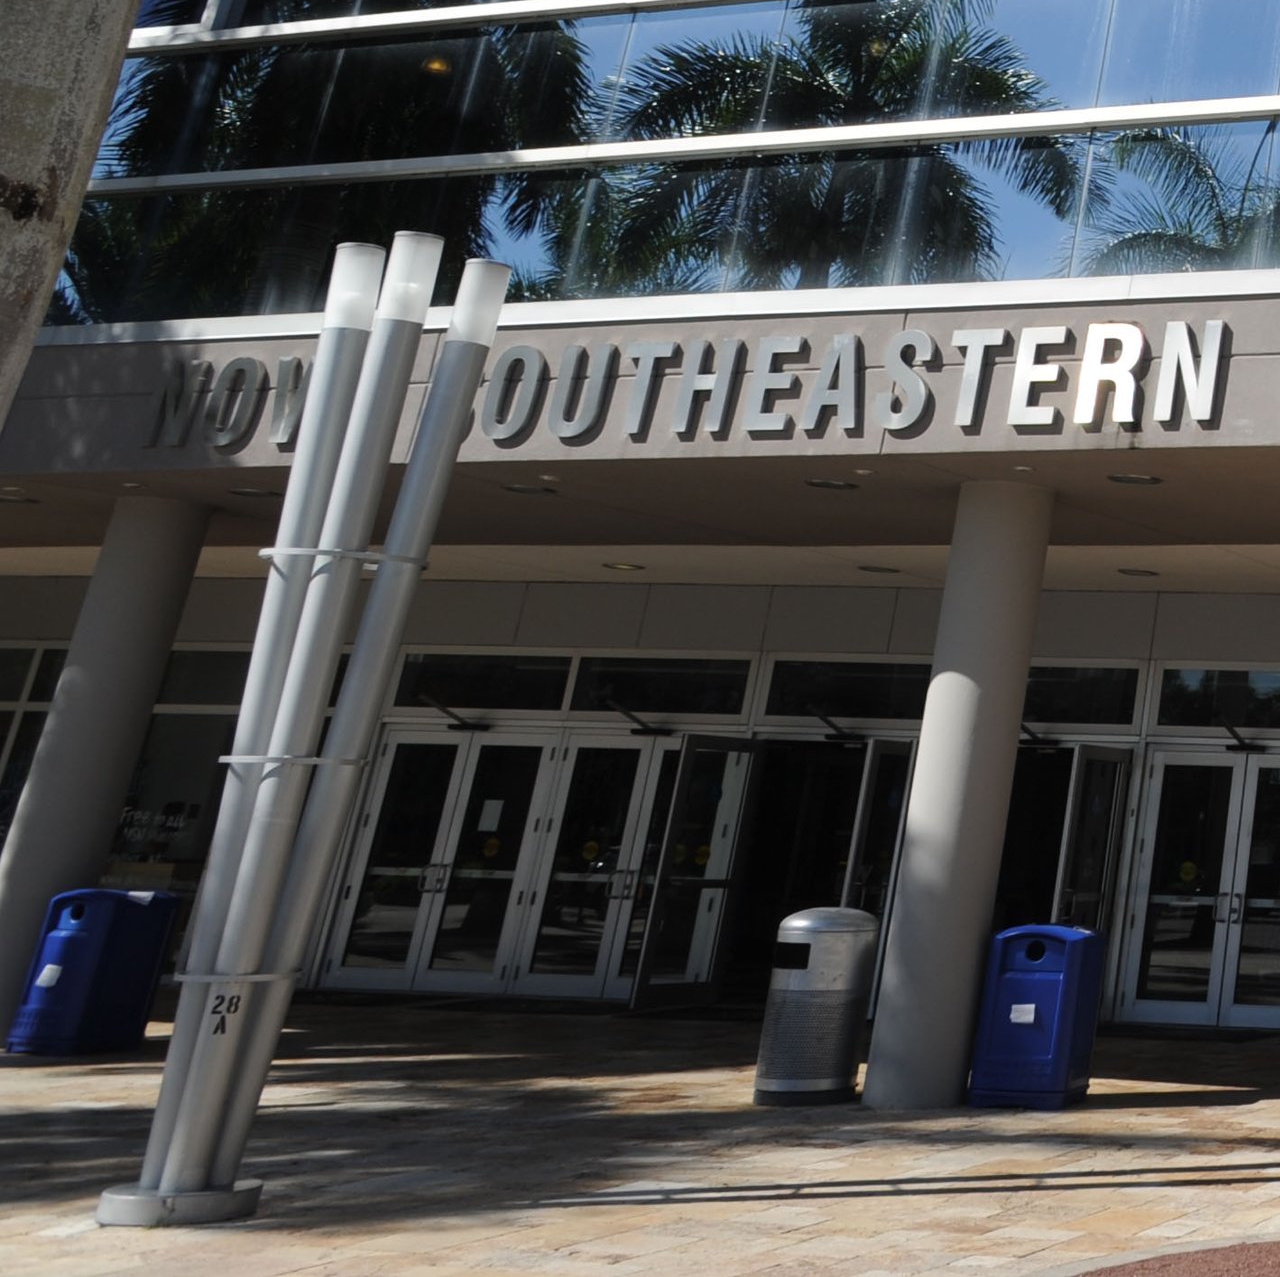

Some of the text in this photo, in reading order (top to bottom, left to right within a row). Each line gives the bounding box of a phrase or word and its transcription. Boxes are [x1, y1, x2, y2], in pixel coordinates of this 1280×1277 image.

[462, 320, 1226, 442] OUTHEASTERN
[211, 995, 241, 1014] 28
[213, 1015, 226, 1035] A
